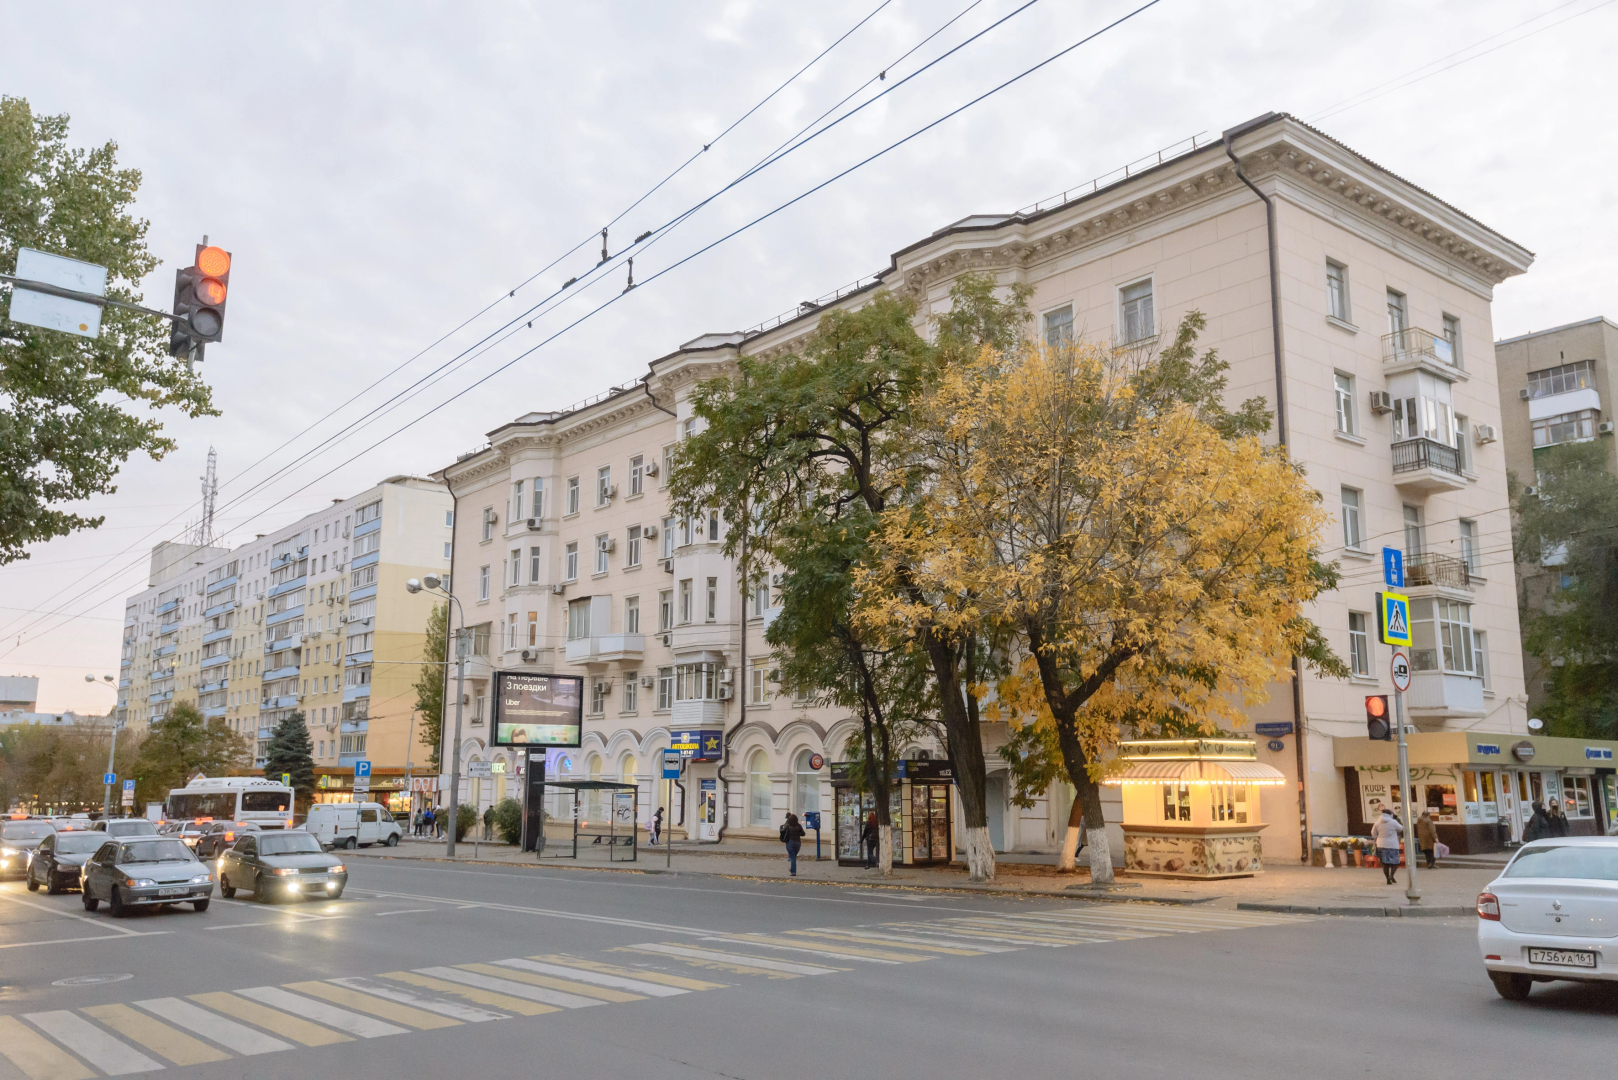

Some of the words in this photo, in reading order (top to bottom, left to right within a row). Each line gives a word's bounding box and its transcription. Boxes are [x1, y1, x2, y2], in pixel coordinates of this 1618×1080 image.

[506, 681, 512, 690] 3
[513, 684, 547, 692] поездки
[505, 698, 520, 706] Uber
[358, 762, 369, 775] P
[1575, 953, 1593, 962] 161
